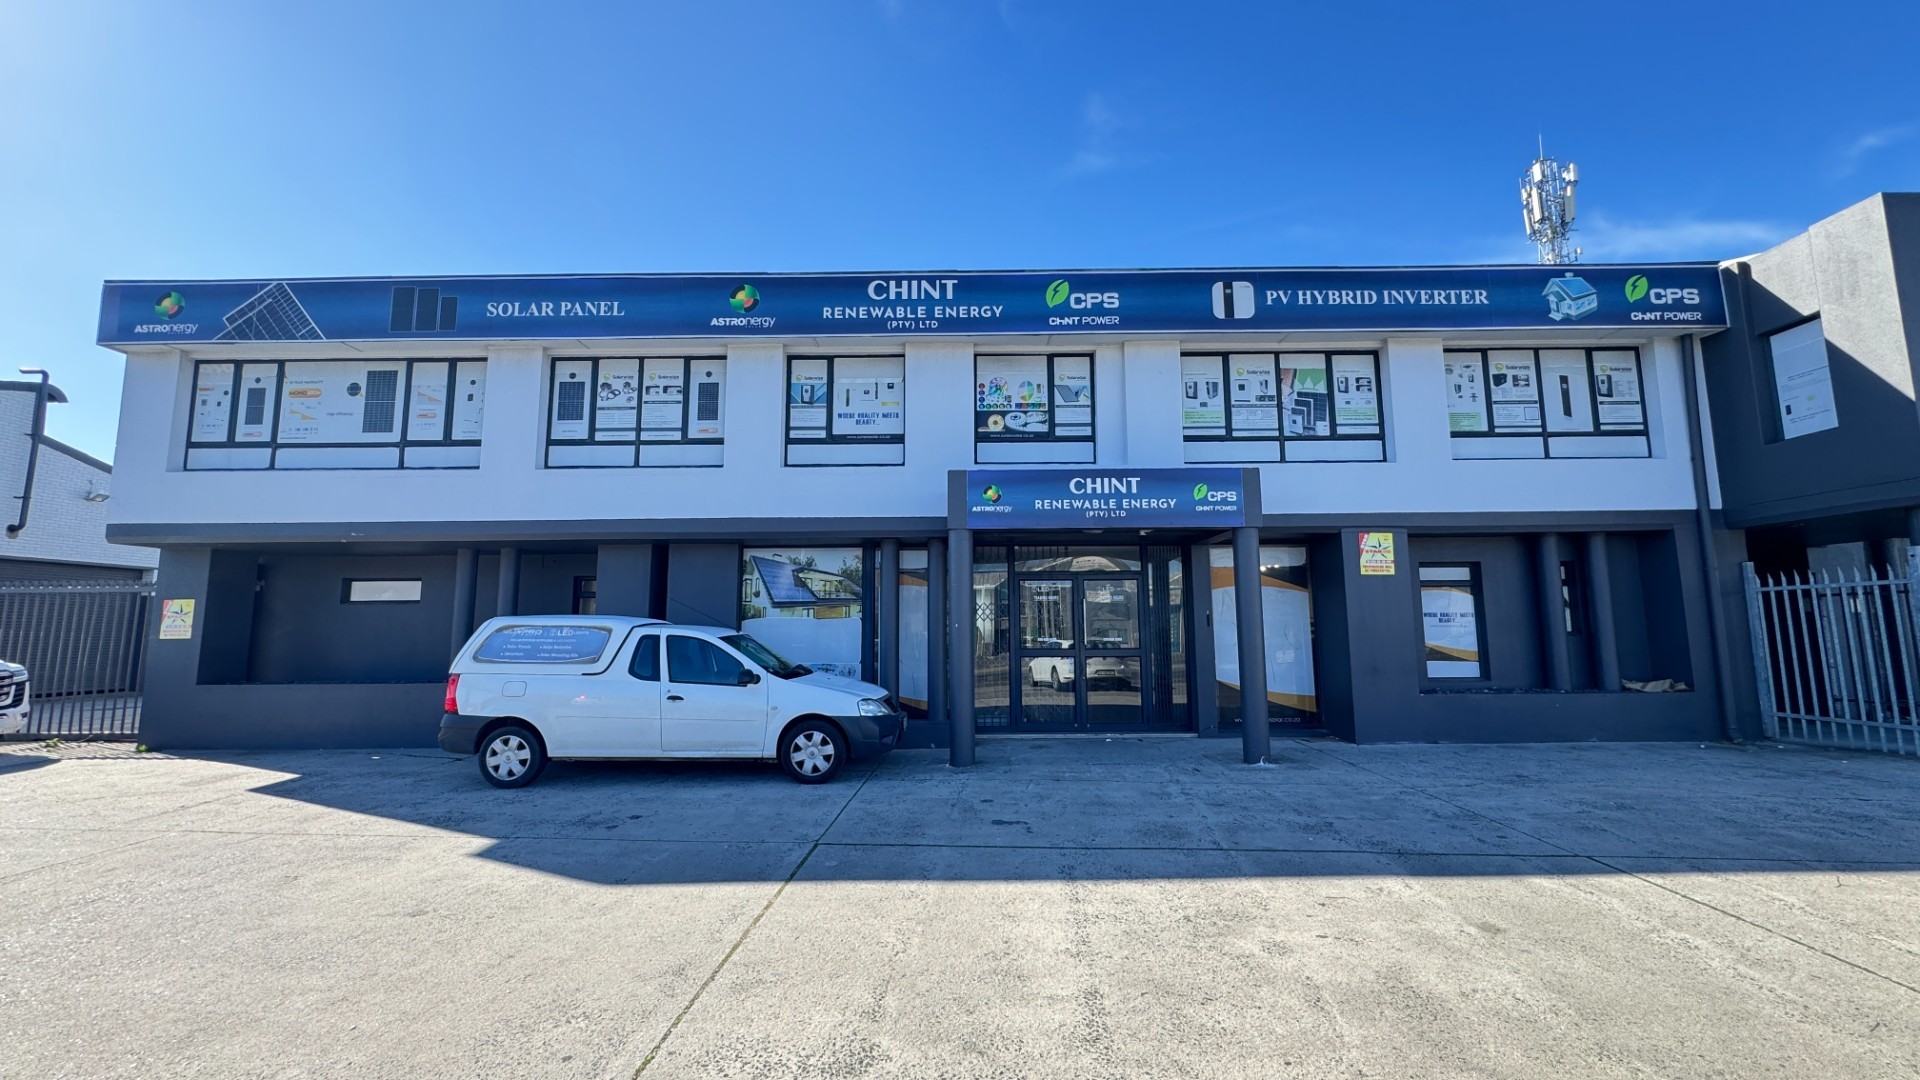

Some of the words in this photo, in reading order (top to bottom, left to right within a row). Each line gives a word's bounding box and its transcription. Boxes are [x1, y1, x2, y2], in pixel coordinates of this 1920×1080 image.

[867, 279, 958, 300] CHINT
[1070, 292, 1120, 309] CPS
[1265, 290, 1291, 305] PV
[1297, 290, 1377, 305] HYBRID
[1382, 289, 1489, 305] INVERTER
[1649, 288, 1700, 304] CPS
[486, 302, 554, 317] SOLAR
[560, 301, 625, 316] PANEL
[822, 306, 927, 318] RENEWABLE
[934, 306, 1003, 318] ENERGY
[1082, 316, 1120, 325] POWER
[1664, 311, 1702, 320] POWER
[887, 320, 915, 329] (PTY)
[919, 320, 938, 328] LTD
[1069, 477, 1141, 494] CHINT
[1207, 491, 1237, 501] CPS
[1035, 499, 1117, 509] RENEWABLE
[1122, 499, 1177, 508] ENERGY
[1086, 510, 1108, 518] (PTY)
